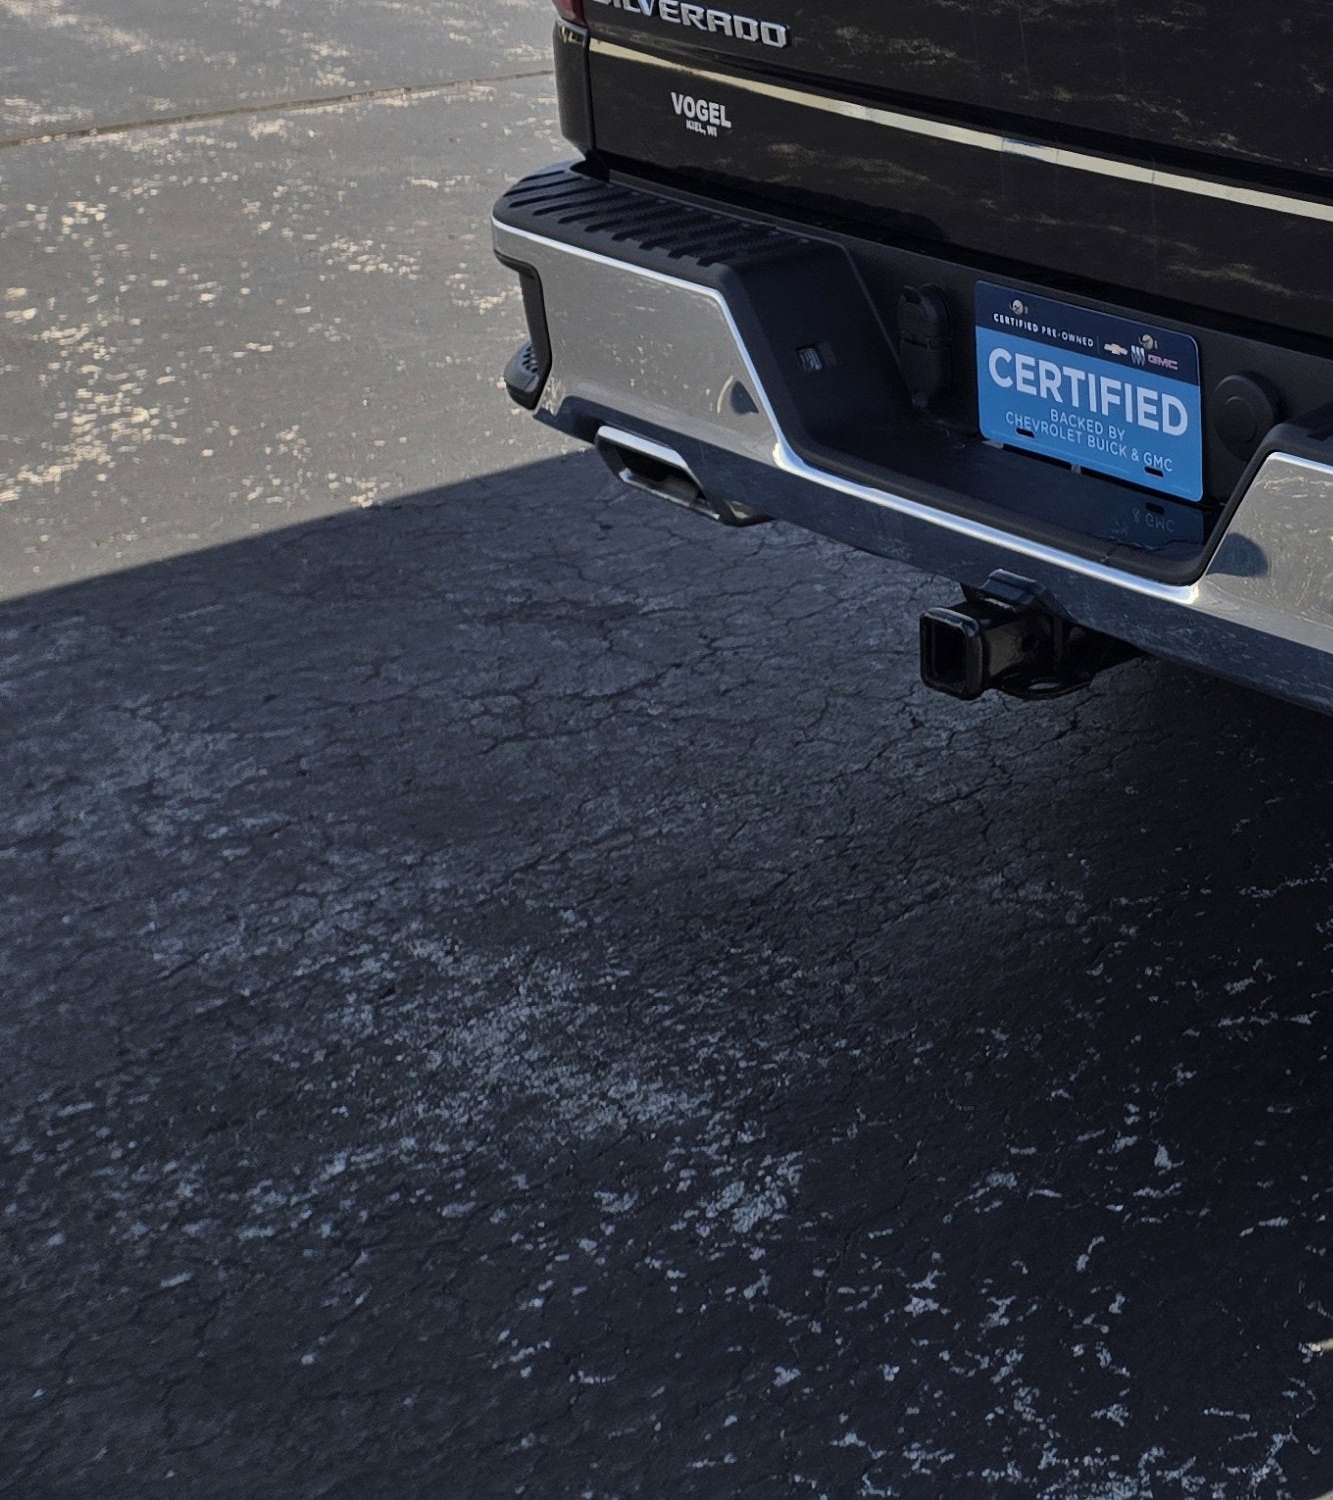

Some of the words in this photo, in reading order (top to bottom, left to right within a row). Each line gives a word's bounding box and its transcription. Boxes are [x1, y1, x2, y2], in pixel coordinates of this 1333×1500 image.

[671, 92, 731, 128] VOGEL
[993, 312, 1039, 334] CERTIFIED
[1041, 325, 1095, 348] PRE-OWNED
[1147, 354, 1179, 371] GMC
[988, 347, 1188, 436] CERTIFIED
[1005, 410, 1083, 445] CHEVROLET
[1087, 434, 1128, 458] BUICK
[1131, 448, 1140, 463] &
[1143, 453, 1174, 473] GMC
[1050, 408, 1104, 435] BACKED
[1108, 424, 1126, 442] BY
